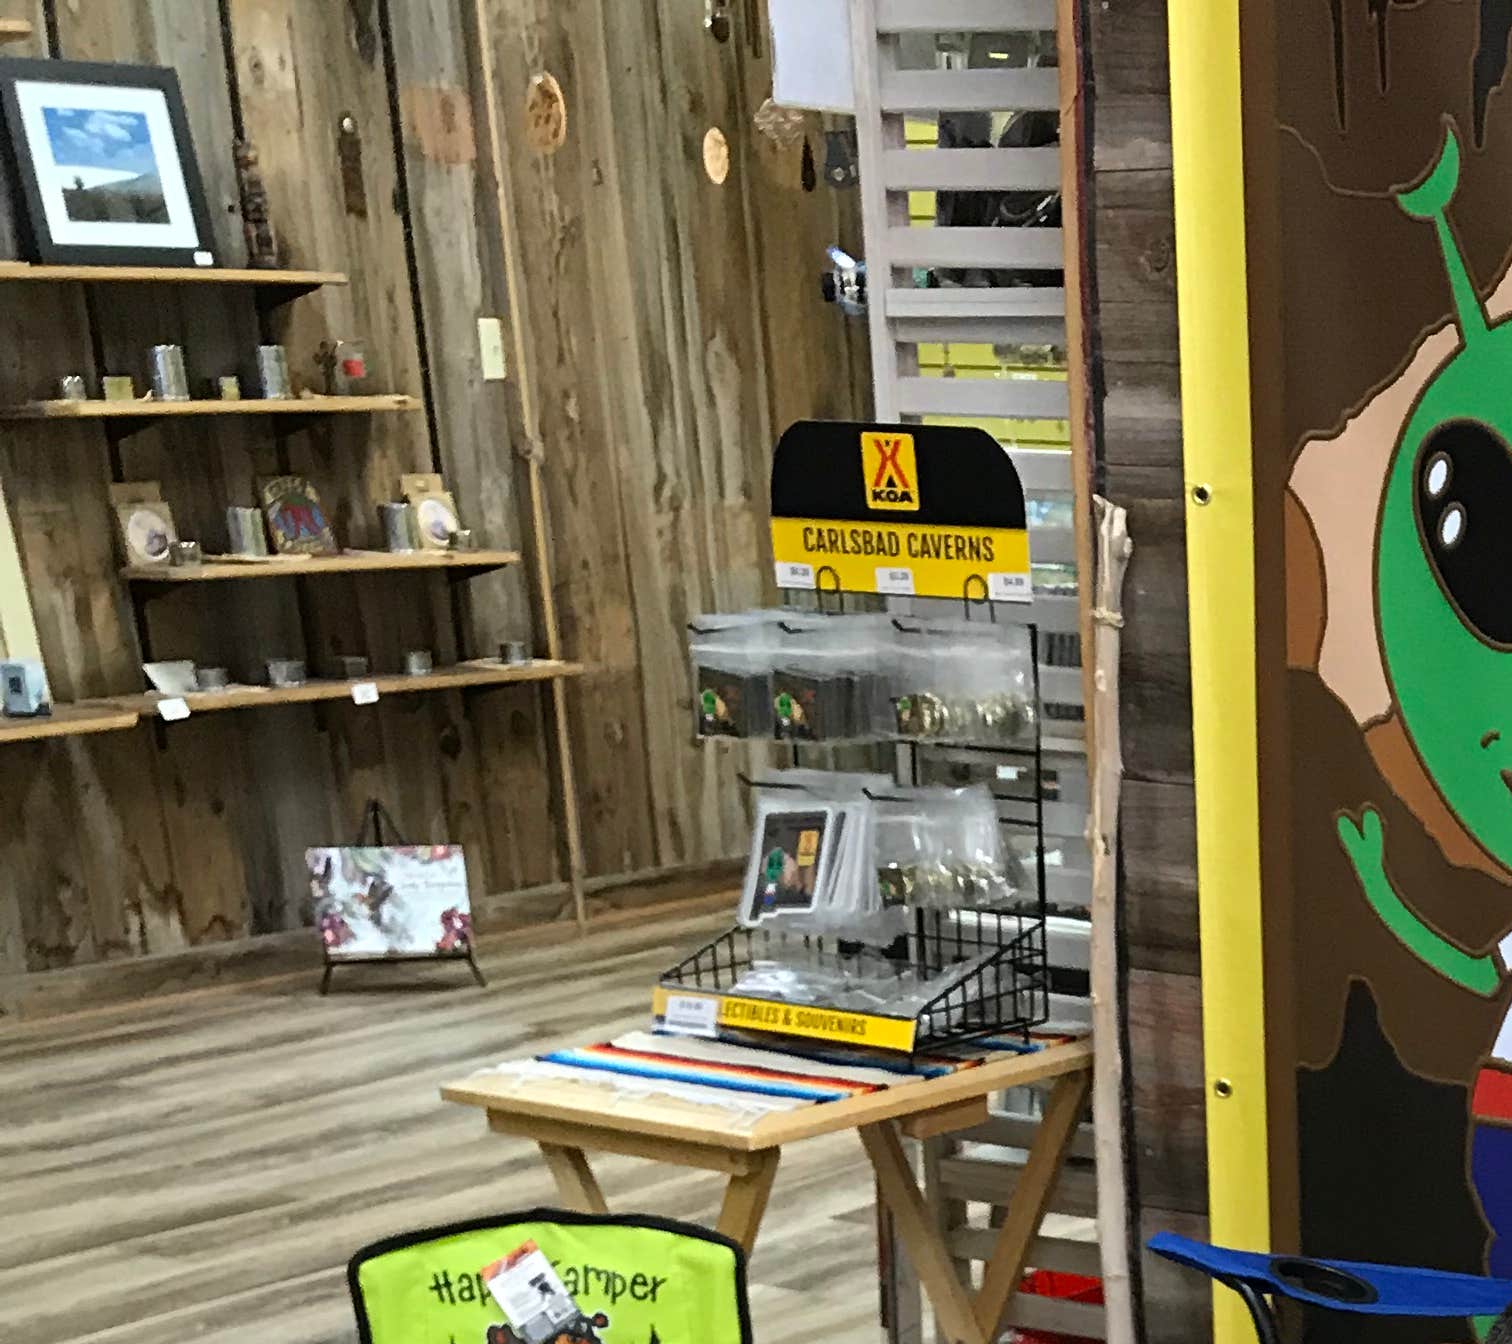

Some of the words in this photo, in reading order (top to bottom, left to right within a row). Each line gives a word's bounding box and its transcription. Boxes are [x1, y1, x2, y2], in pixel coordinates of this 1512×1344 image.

[871, 488, 914, 504] KOA
[802, 526, 900, 558] CARLSBAD
[906, 532, 995, 563] CAVERNS
[550, 1259, 668, 1305] amper
